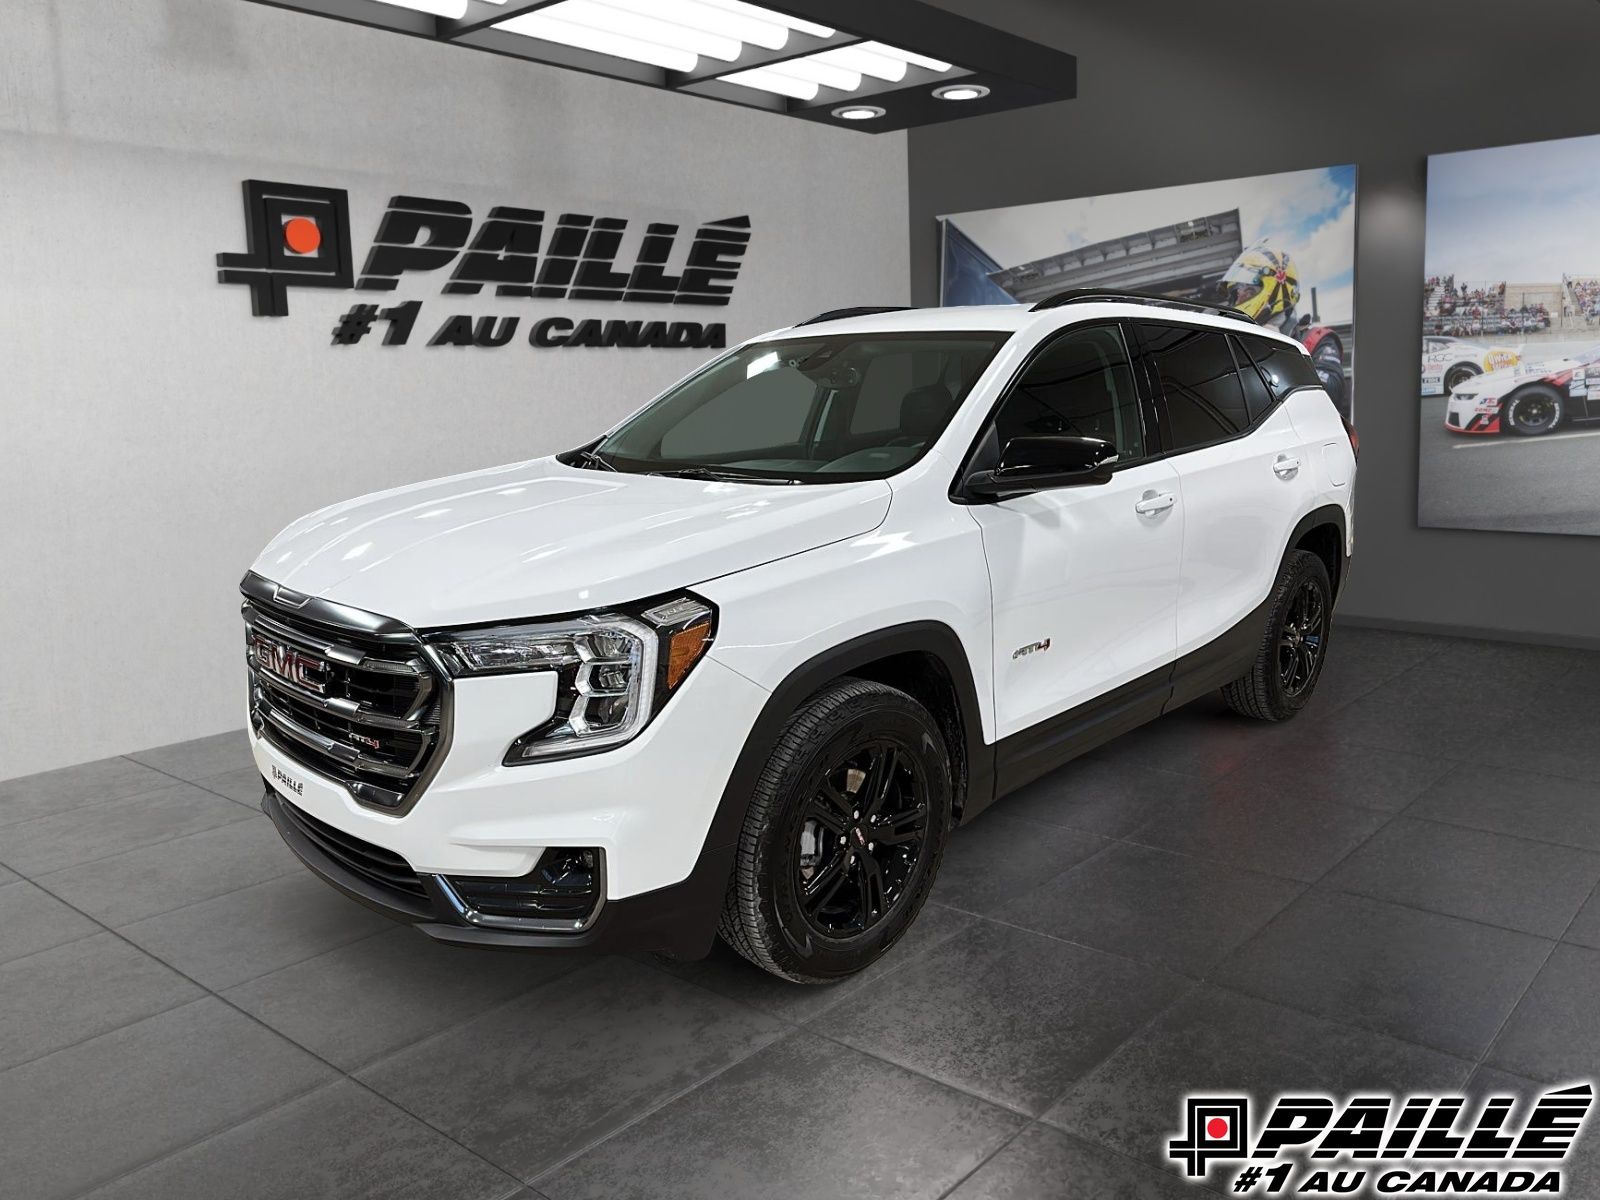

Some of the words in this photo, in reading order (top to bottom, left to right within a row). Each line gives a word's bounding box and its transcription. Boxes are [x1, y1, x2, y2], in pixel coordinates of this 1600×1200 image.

[355, 195, 752, 307] PAILLÉ
[330, 300, 423, 346] #1
[427, 315, 520, 347] AU
[529, 317, 727, 349] CANADA
[252, 633, 326, 694] GMC
